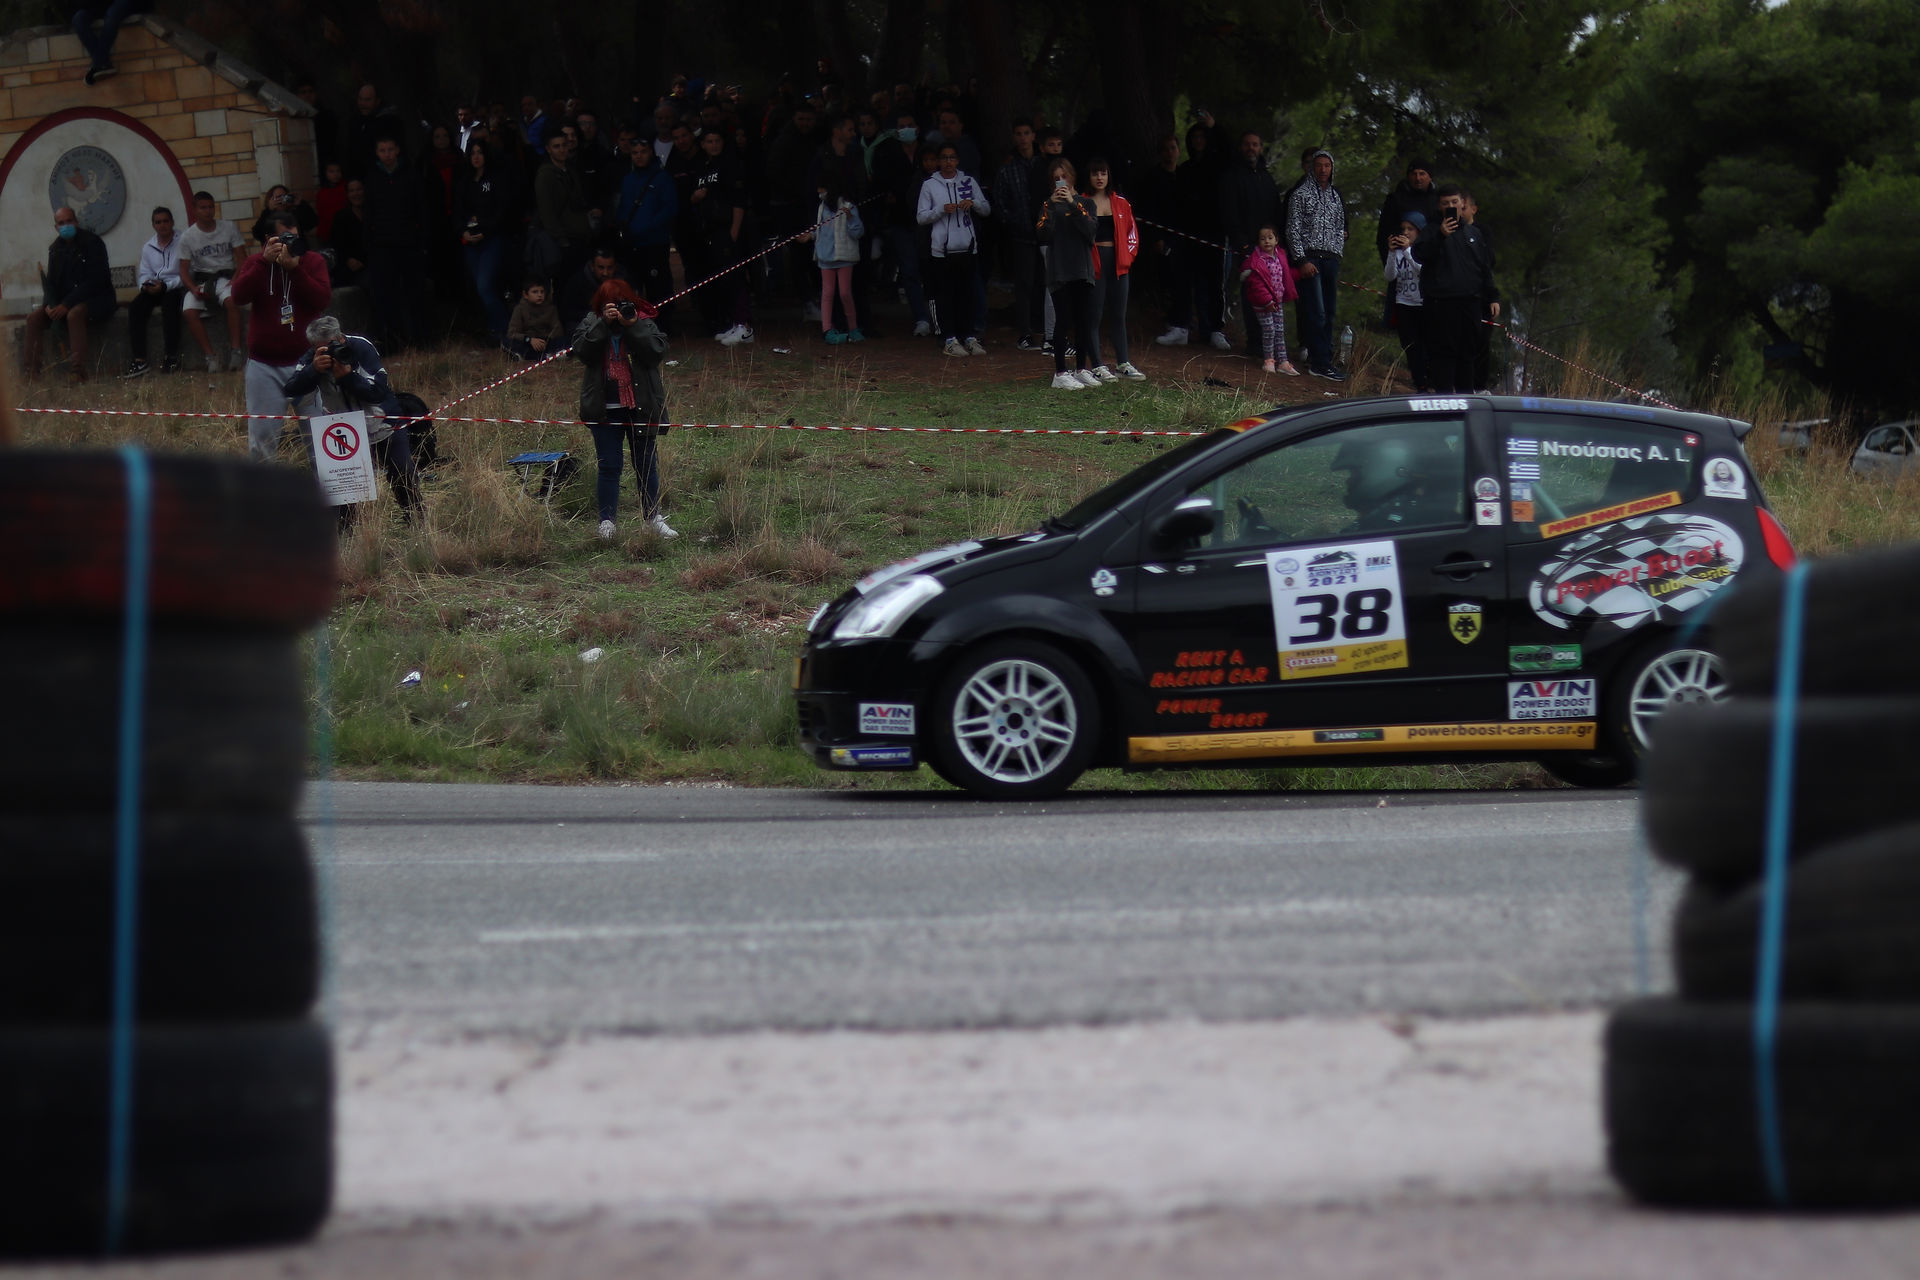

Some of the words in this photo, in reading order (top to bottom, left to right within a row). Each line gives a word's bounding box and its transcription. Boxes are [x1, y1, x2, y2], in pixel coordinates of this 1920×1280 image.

[1408, 399, 1470, 412] VELEGOS
[1542, 441, 1643, 463] Ντούσιας
[1556, 562, 1642, 605] Power
[1647, 539, 1725, 579] Boost
[1308, 574, 1358, 588] 2021
[1289, 588, 1393, 645] 38
[1175, 650, 1228, 668] RENT
[1229, 649, 1246, 665] A
[1291, 656, 1336, 667] SPECIAL
[1149, 668, 1225, 688] RACING
[1228, 666, 1270, 684] CAR
[1512, 680, 1591, 698] AVIN
[1155, 698, 1223, 714] POWER
[1513, 700, 1550, 708] POWER
[1554, 698, 1592, 707] BOOST
[863, 706, 911, 718] AVIN
[1209, 711, 1269, 728] BOOST
[1516, 710, 1538, 719] GAS
[1542, 708, 1588, 718] STATION
[1407, 724, 1594, 739] powerboost-cars.car.gr
